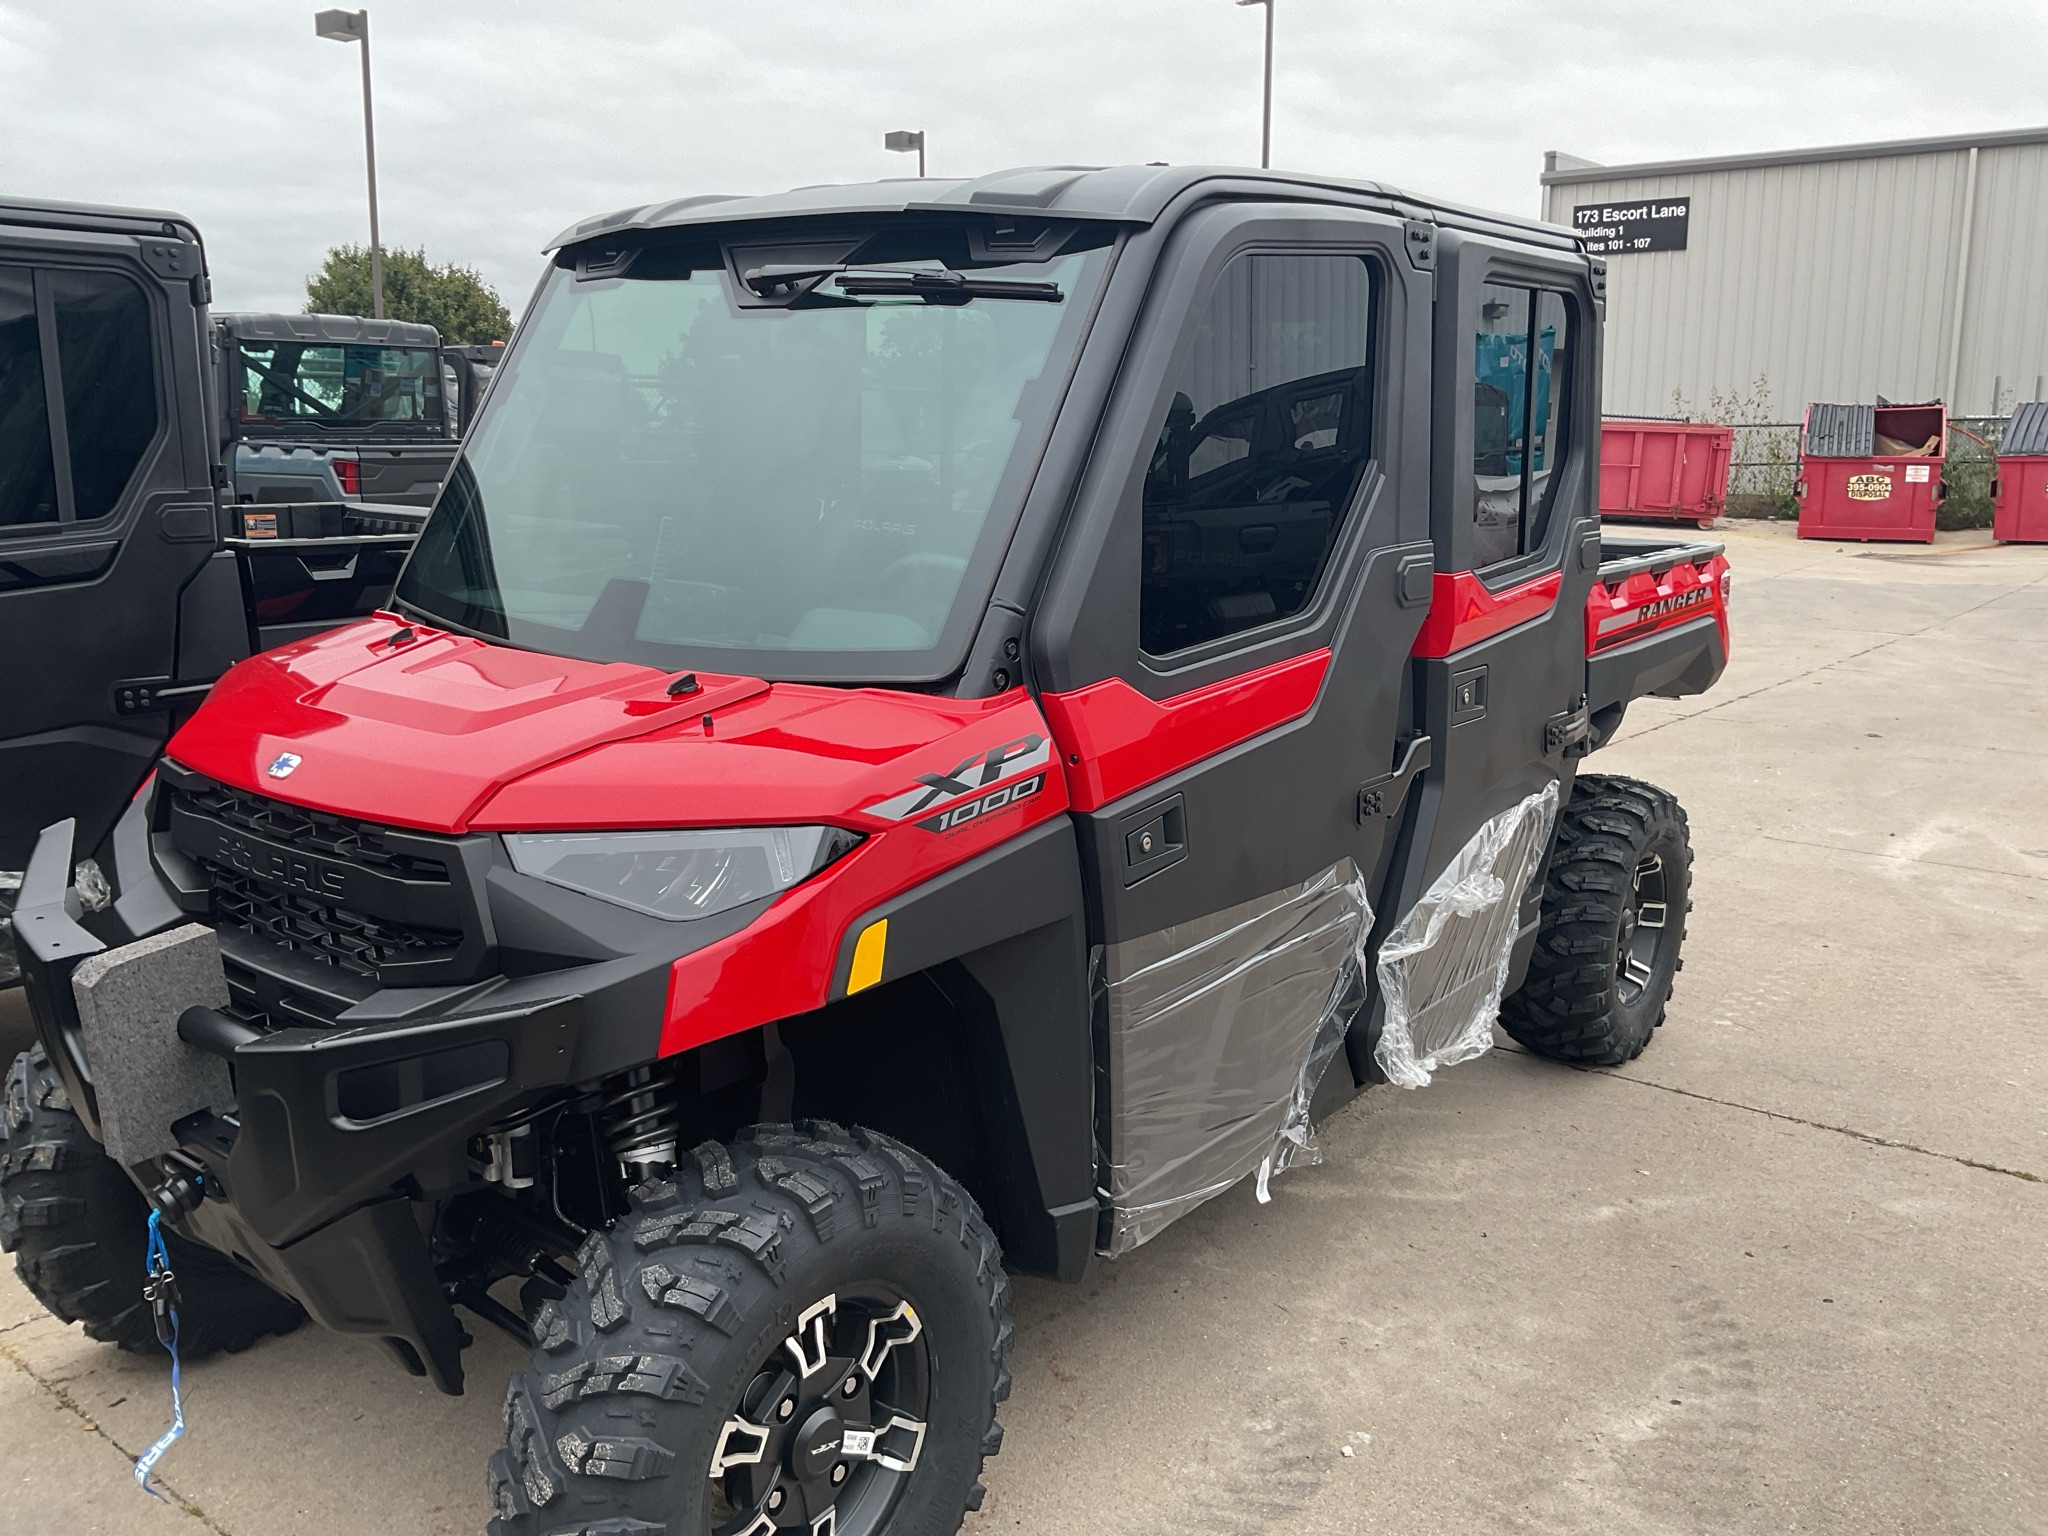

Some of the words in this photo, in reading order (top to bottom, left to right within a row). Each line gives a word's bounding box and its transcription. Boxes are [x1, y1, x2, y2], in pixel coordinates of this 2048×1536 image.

[1576, 209, 1600, 224] 173
[1602, 206, 1649, 222] Escort
[1651, 203, 1687, 219] Lane
[1618, 225, 1625, 236] 1
[1586, 241, 1605, 252] ites
[1607, 239, 1624, 251] 101
[1633, 237, 1652, 250] 107
[1847, 483, 1893, 492] 395-0904
[854, 519, 917, 536] POLARIS
[1636, 586, 1708, 623] RANGER
[901, 732, 1046, 818] XP
[939, 776, 1040, 831] 1000
[215, 835, 346, 900] POLARIS
